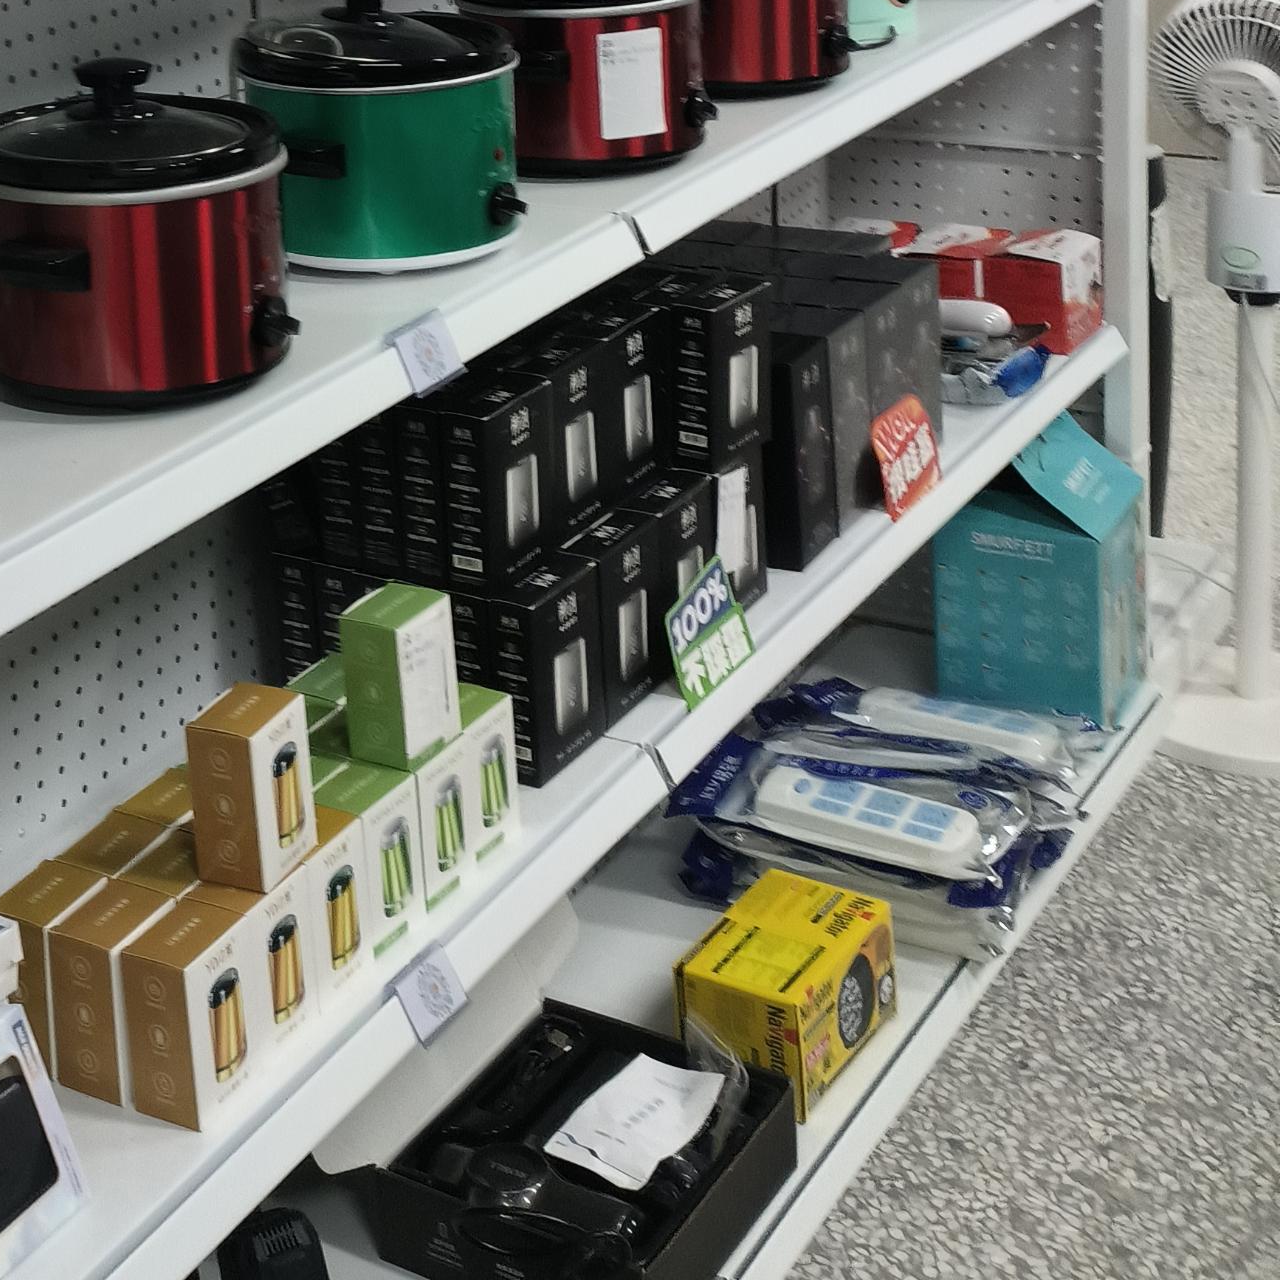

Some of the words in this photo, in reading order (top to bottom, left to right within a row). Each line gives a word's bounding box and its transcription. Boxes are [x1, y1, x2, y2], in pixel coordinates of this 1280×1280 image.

[671, 567, 729, 657] 100%
[823, 896, 877, 939] Navigator
[763, 1004, 789, 1075] Navigato
